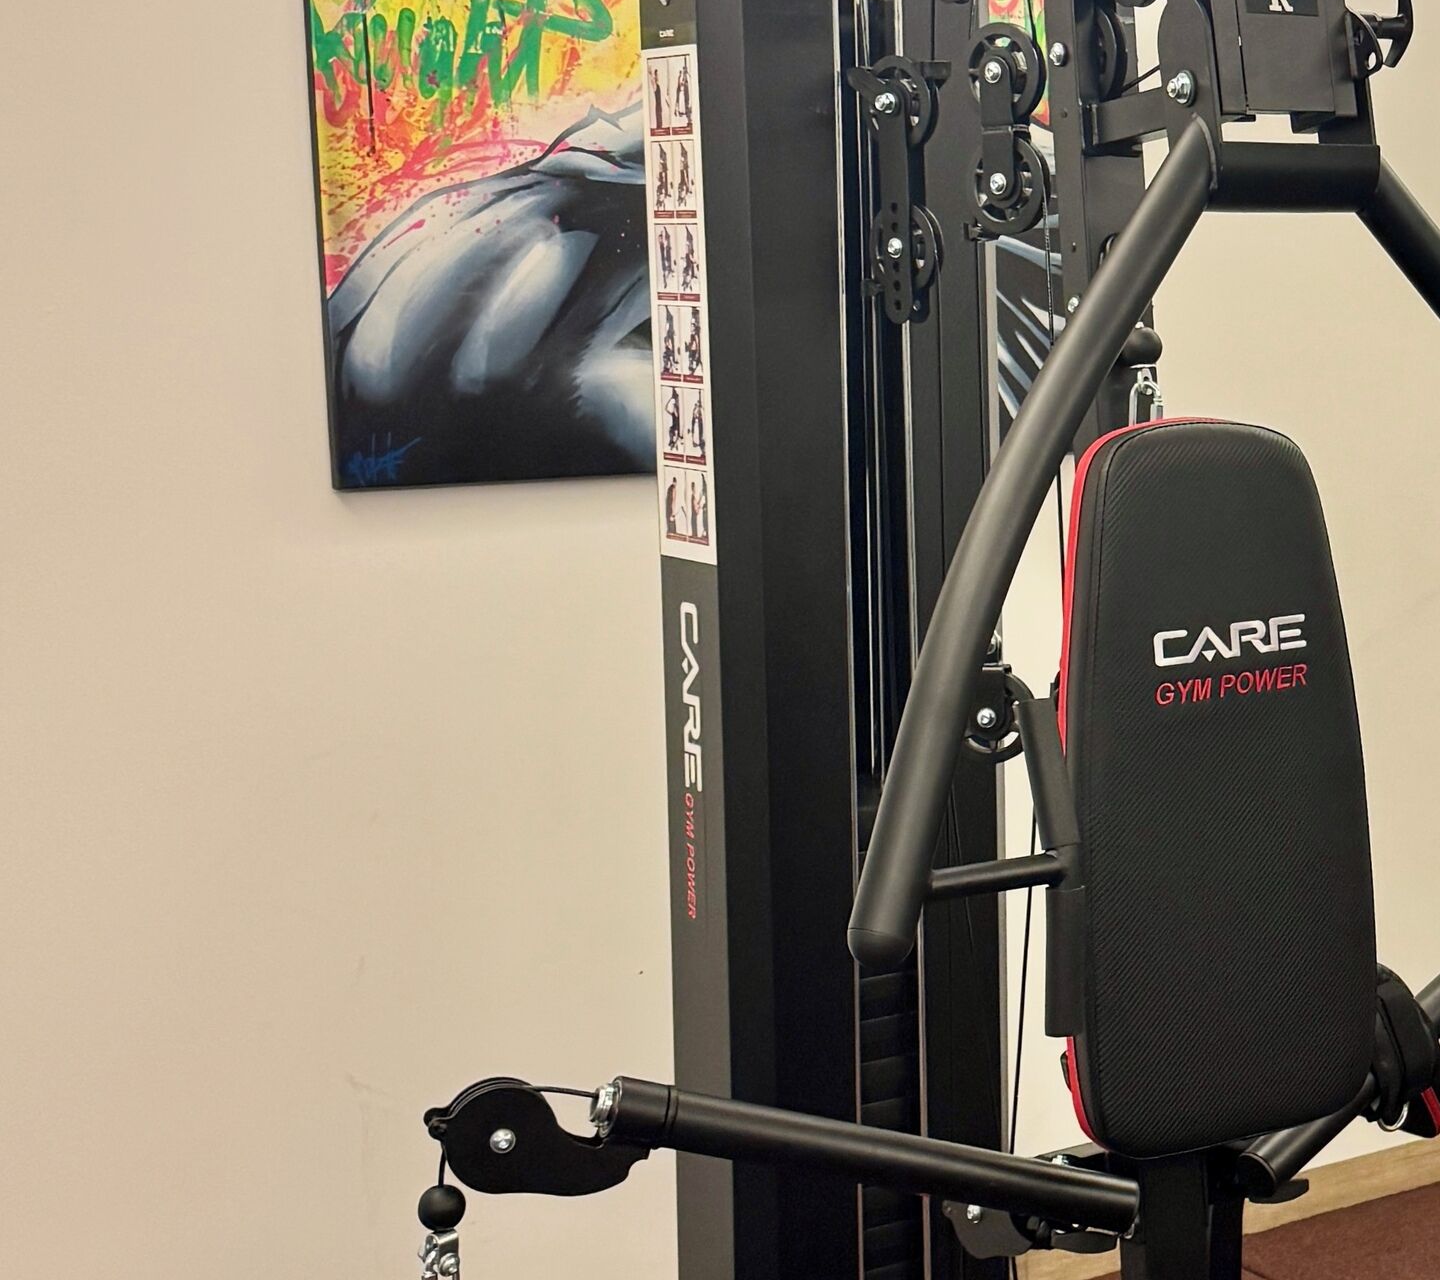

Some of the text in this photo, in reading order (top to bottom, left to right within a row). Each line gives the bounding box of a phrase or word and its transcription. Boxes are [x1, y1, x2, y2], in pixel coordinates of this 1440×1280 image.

[1153, 613, 1307, 667] CARE
[1155, 663, 1309, 706] GYM POWER
[680, 600, 703, 793] CARE
[685, 792, 697, 919] GYM POWER
